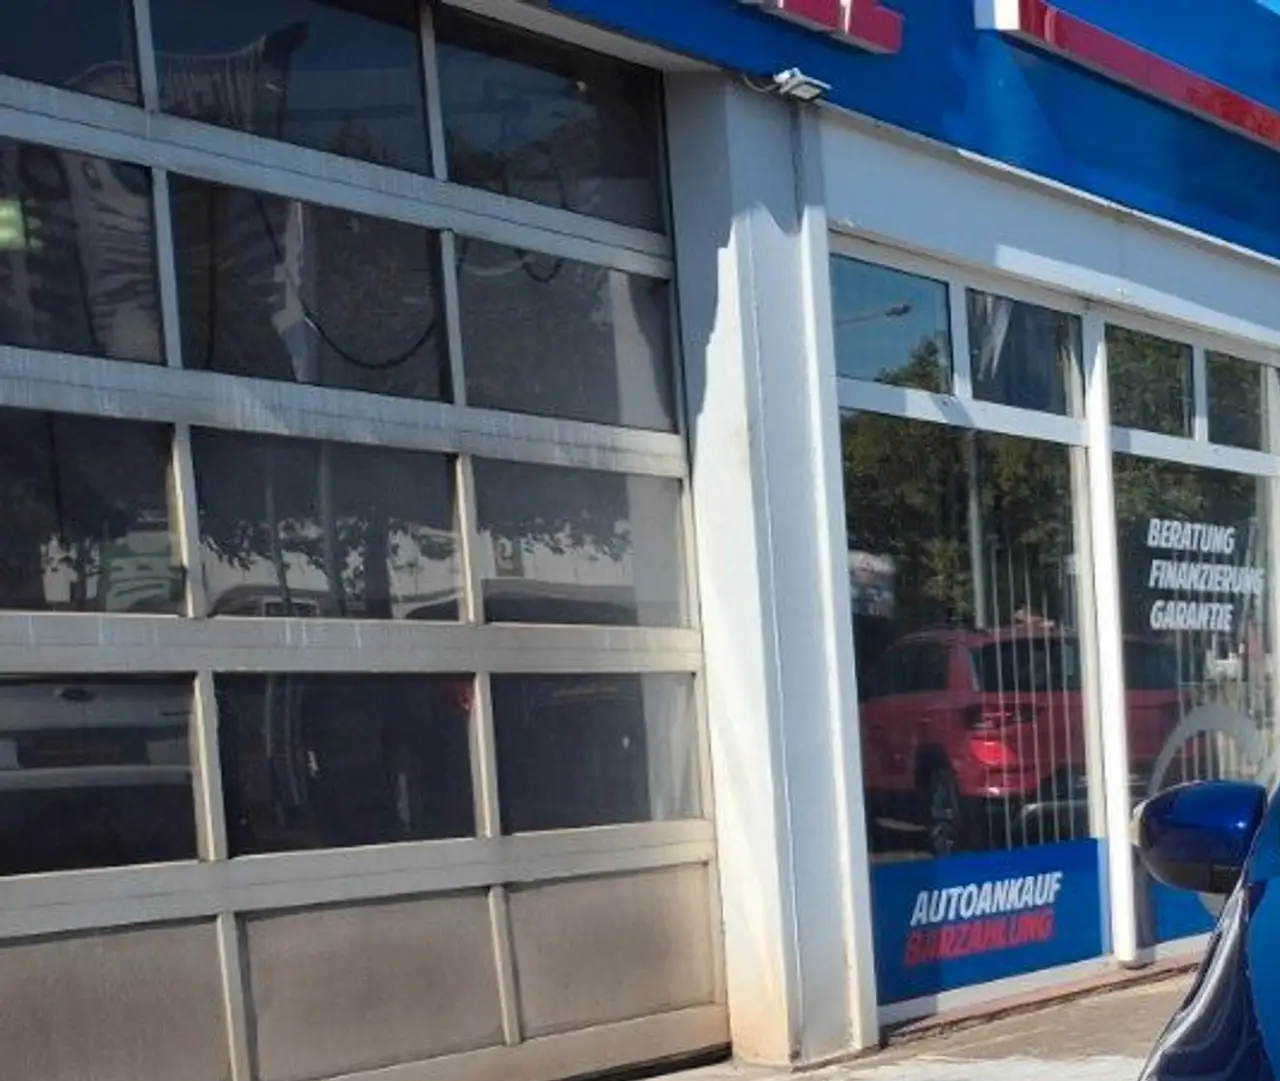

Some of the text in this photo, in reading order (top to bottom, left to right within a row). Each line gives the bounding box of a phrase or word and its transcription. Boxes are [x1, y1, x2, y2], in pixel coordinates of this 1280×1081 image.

[1146, 518, 1237, 554] BERATUNG
[1148, 559, 1265, 596] FINANZIERUNG
[1149, 599, 1235, 631] GARANTIE
[909, 869, 1064, 927] AUTOANKAUF
[904, 906, 1055, 968] BARZAHLUNG
